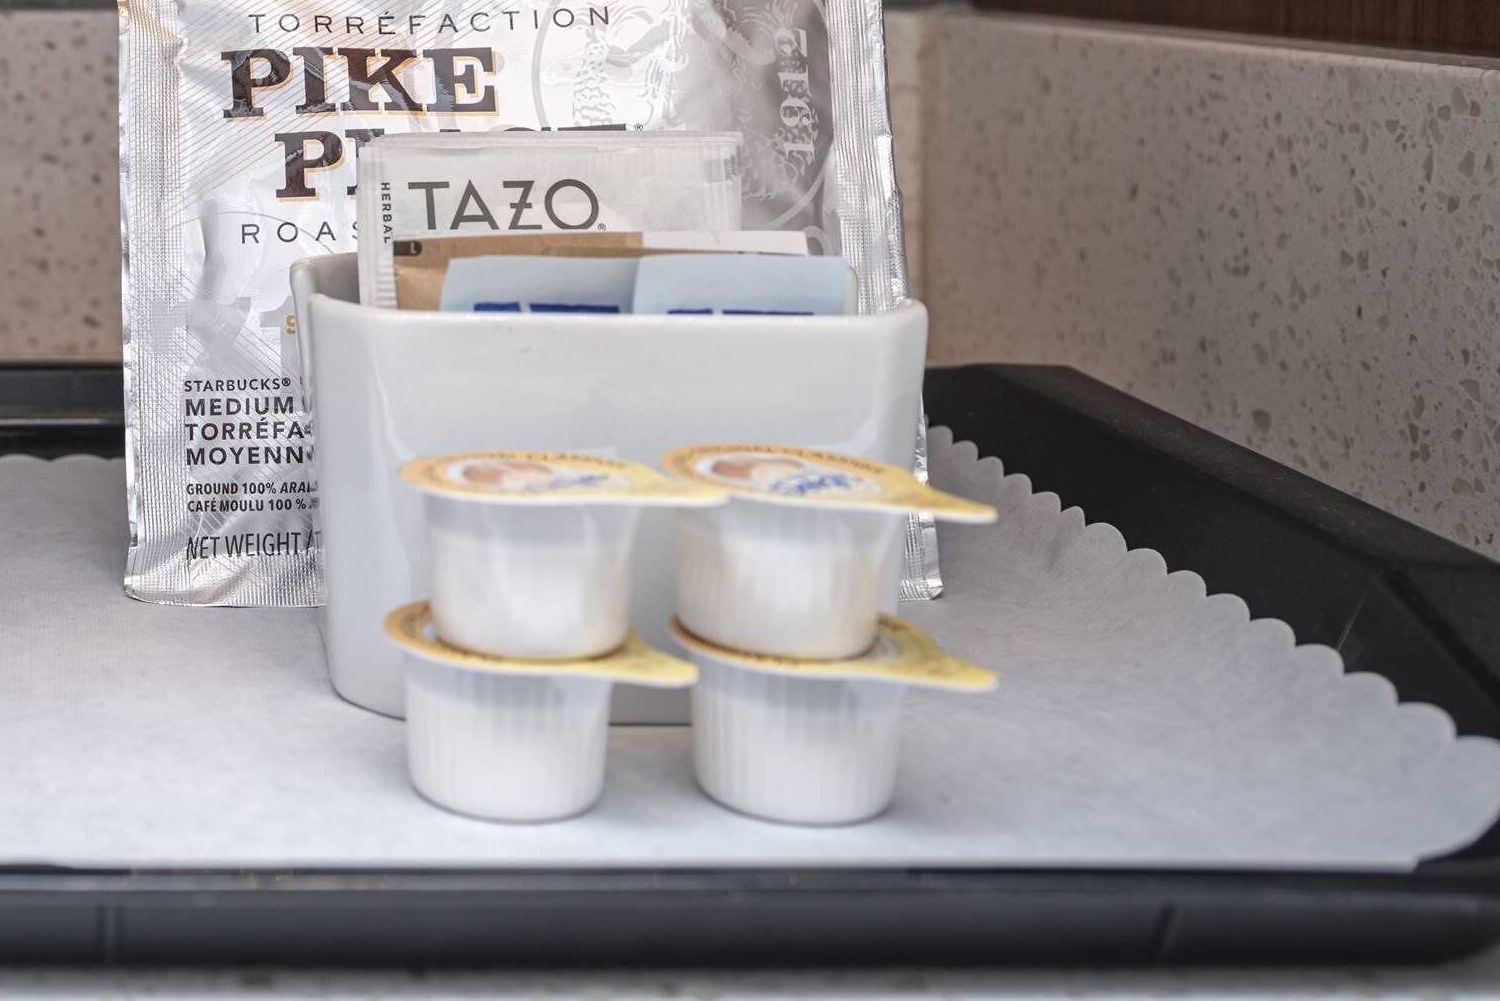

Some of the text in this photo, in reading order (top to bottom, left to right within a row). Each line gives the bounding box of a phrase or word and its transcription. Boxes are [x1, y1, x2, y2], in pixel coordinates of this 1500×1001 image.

[248, 5, 611, 36] TORRÉFACTION
[221, 46, 500, 122] PIKE
[776, 26, 817, 161] 1912
[380, 182, 392, 245] HERBAL
[185, 396, 294, 416] MEDIUM
[185, 417, 306, 441] TORRÉFA
[186, 446, 304, 466] MOYENN
[186, 482, 238, 495] GROUND
[242, 482, 276, 495] 100%
[187, 498, 217, 512] CAFÉ
[219, 499, 264, 512] MOULU
[268, 499, 292, 510] 100
[186, 536, 221, 560] NET
[225, 532, 301, 558] WEIGHT
